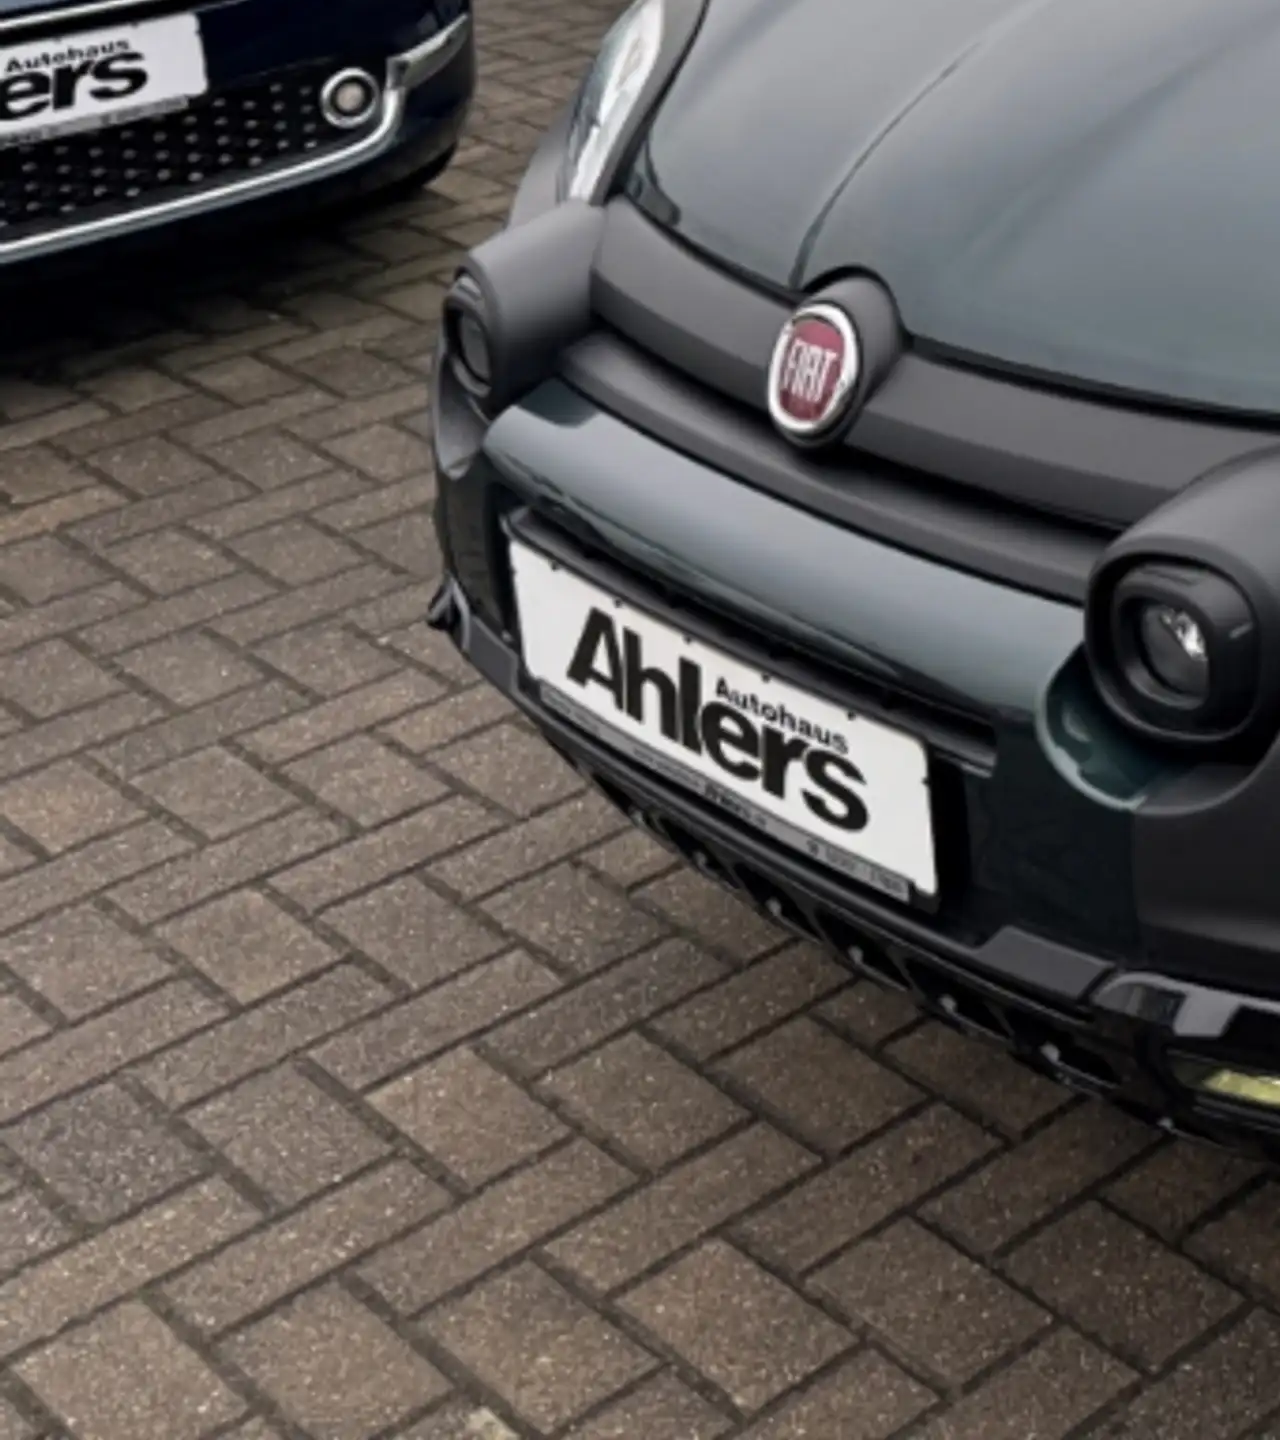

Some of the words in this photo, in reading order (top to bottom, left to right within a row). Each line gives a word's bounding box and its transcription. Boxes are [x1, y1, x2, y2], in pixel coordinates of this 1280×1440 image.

[6, 39, 131, 73] Autohaus
[783, 336, 839, 402] FIAT
[566, 606, 870, 834] Ahlers
[715, 676, 849, 756] Autohaus
